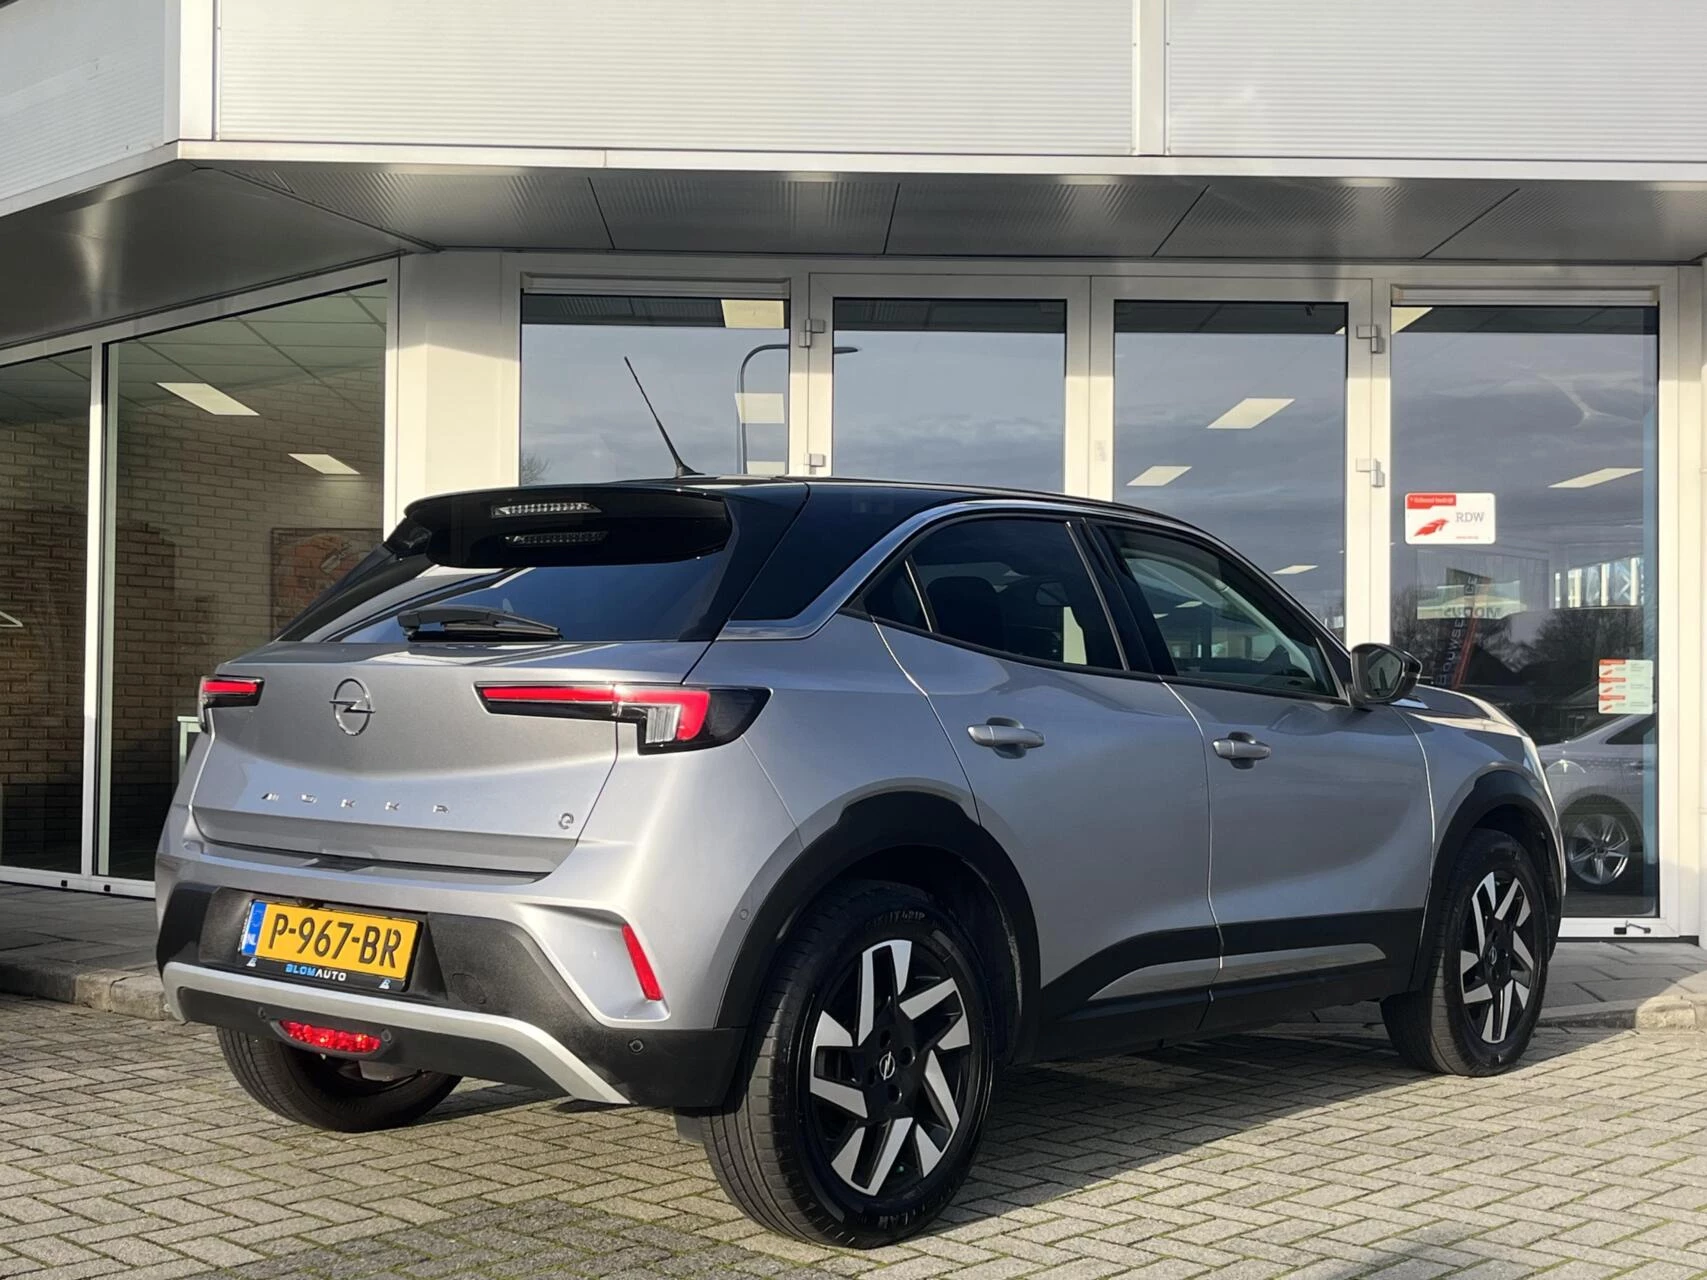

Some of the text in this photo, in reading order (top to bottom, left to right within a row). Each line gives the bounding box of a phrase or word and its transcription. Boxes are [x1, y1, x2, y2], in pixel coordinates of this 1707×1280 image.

[1455, 511, 1486, 523] RDW
[268, 913, 402, 969] P-967-BR
[285, 963, 347, 982] BLOMAUTO
